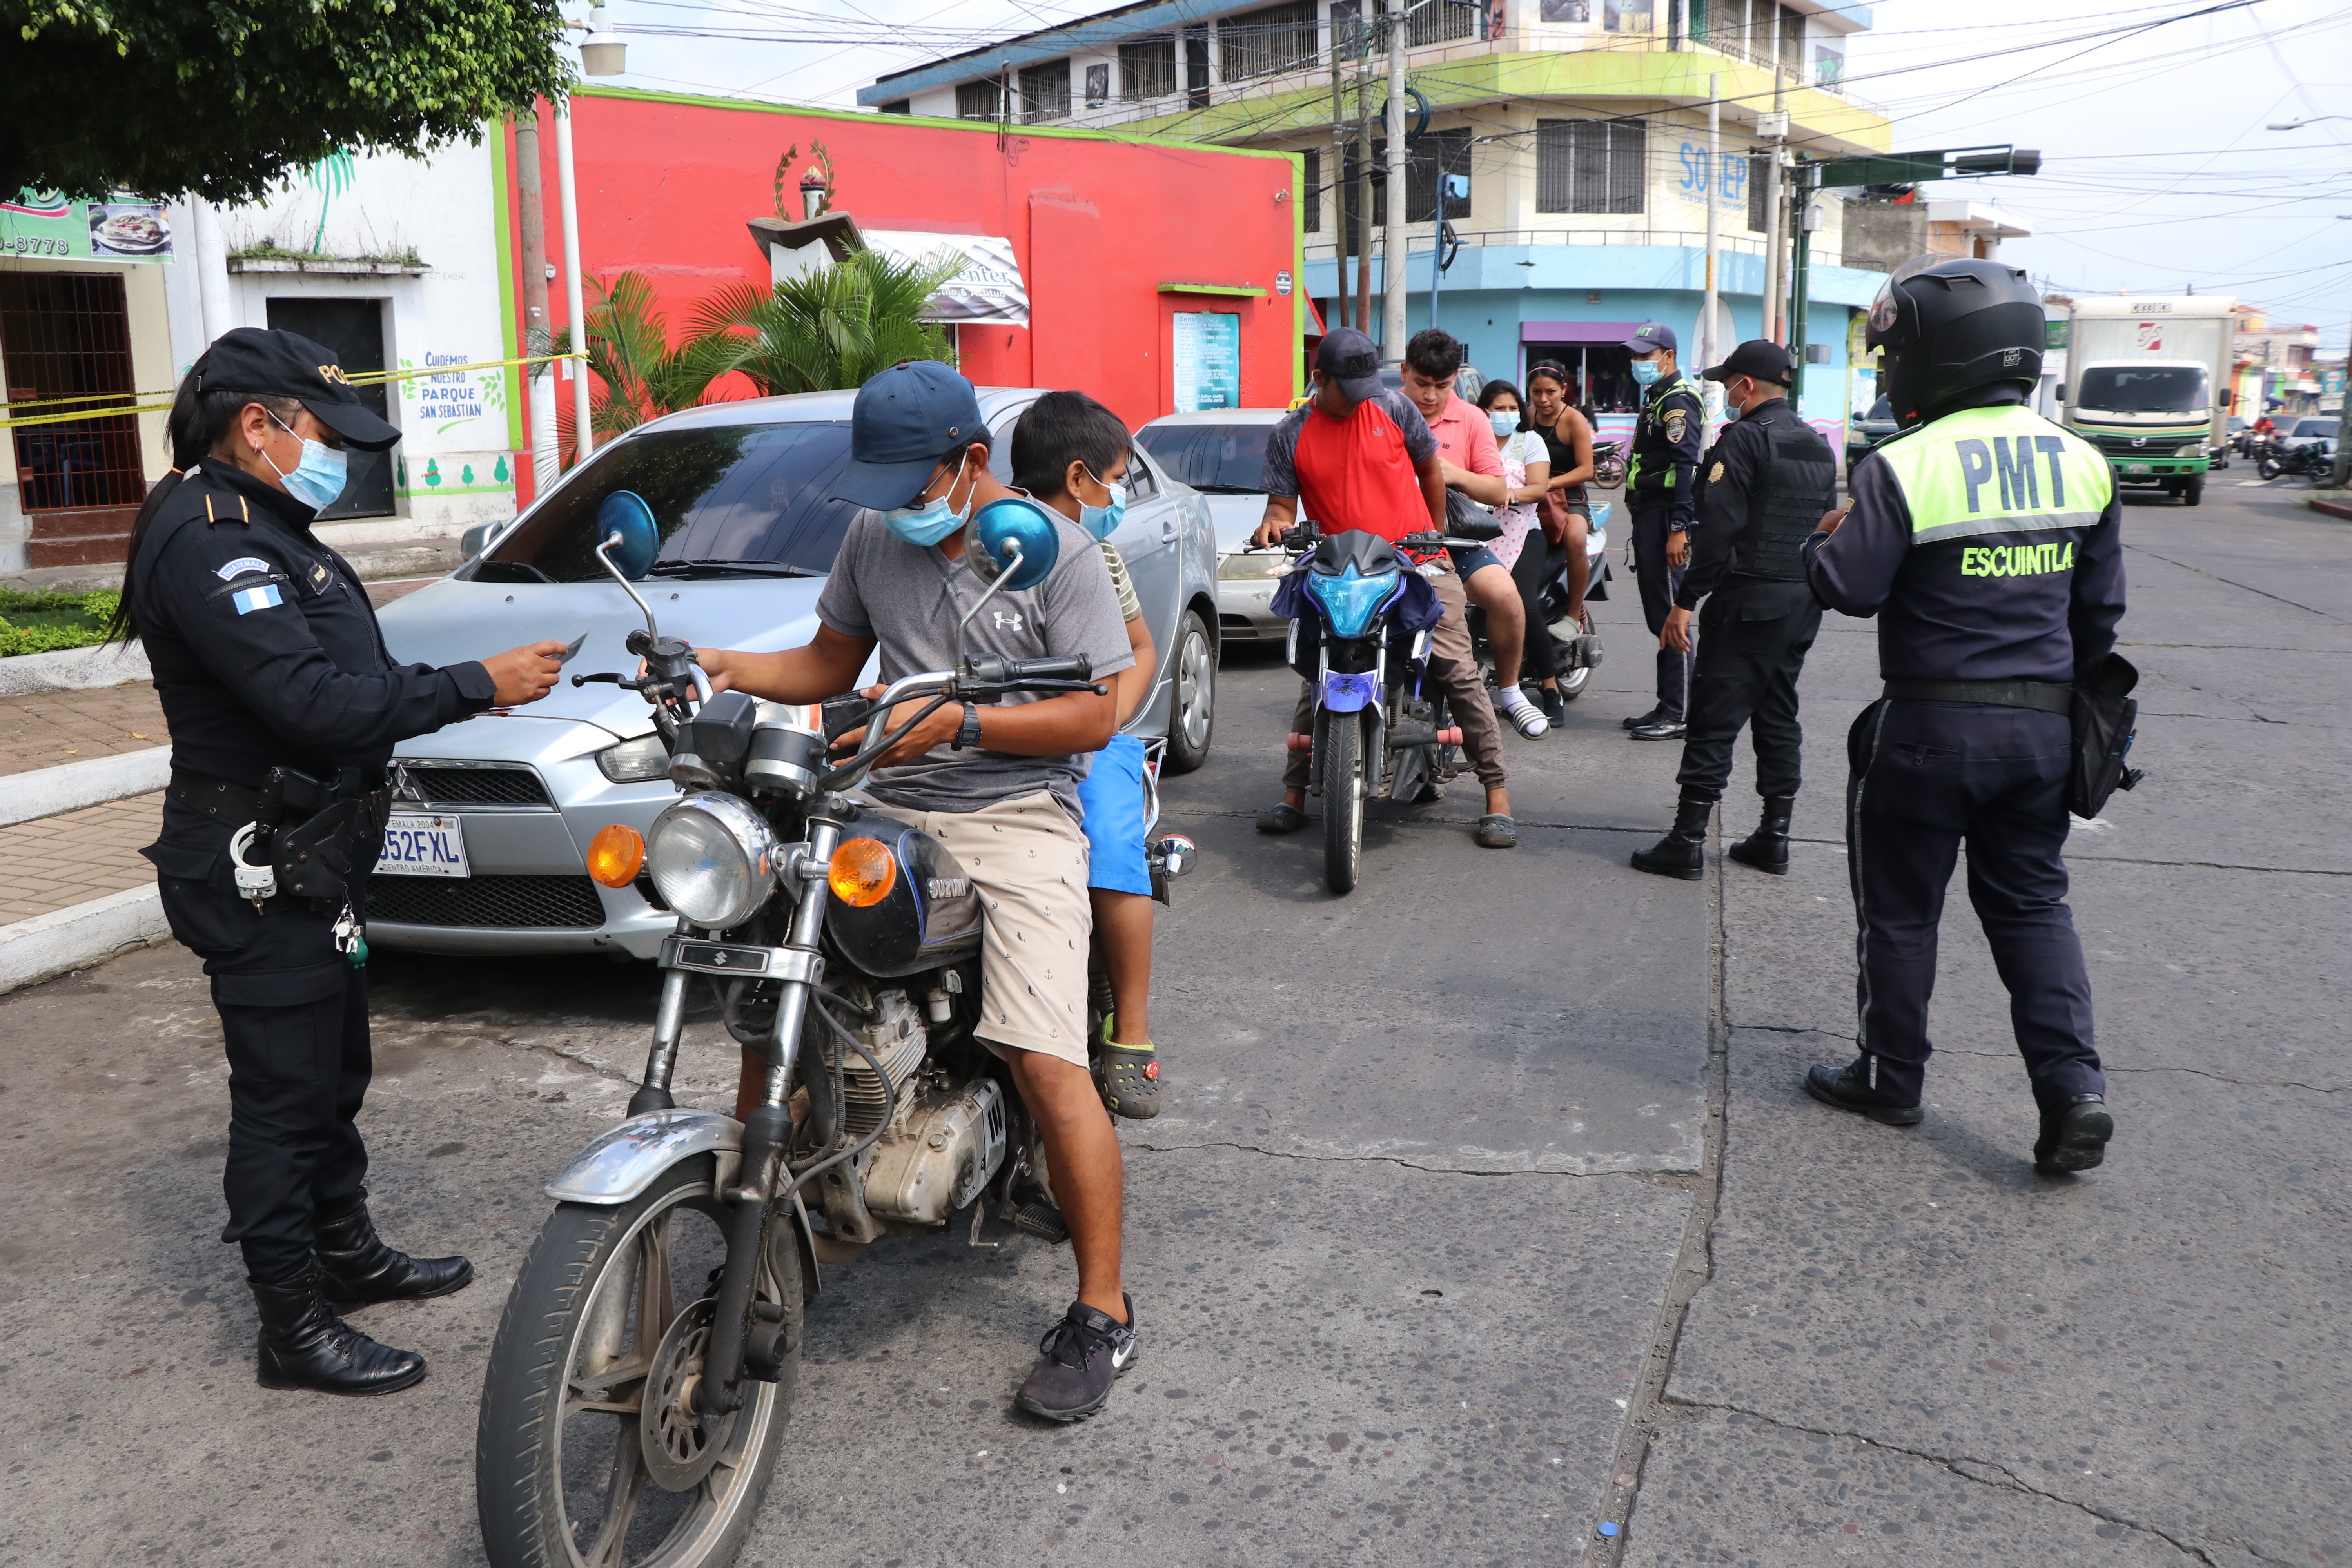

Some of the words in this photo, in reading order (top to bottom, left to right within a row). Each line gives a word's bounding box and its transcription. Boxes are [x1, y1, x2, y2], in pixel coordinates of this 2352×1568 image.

[971, 289, 1006, 298] Actitud
[431, 370, 465, 384] NUESTRO
[422, 388, 475, 402] PARQUE
[420, 406, 437, 419] SAN
[439, 403, 481, 419] SEBASTIAN
[1955, 435, 2066, 513] PMT
[1961, 542, 2074, 577] ESCUINTLA
[223, 561, 265, 576] GUATEMALA
[417, 820, 434, 828] 2004
[383, 864, 410, 872] CENTRO
[412, 863, 443, 873] AMÉRICA
[930, 879, 966, 899] SUZUKI
[1092, 1315, 1109, 1325] NIKE
